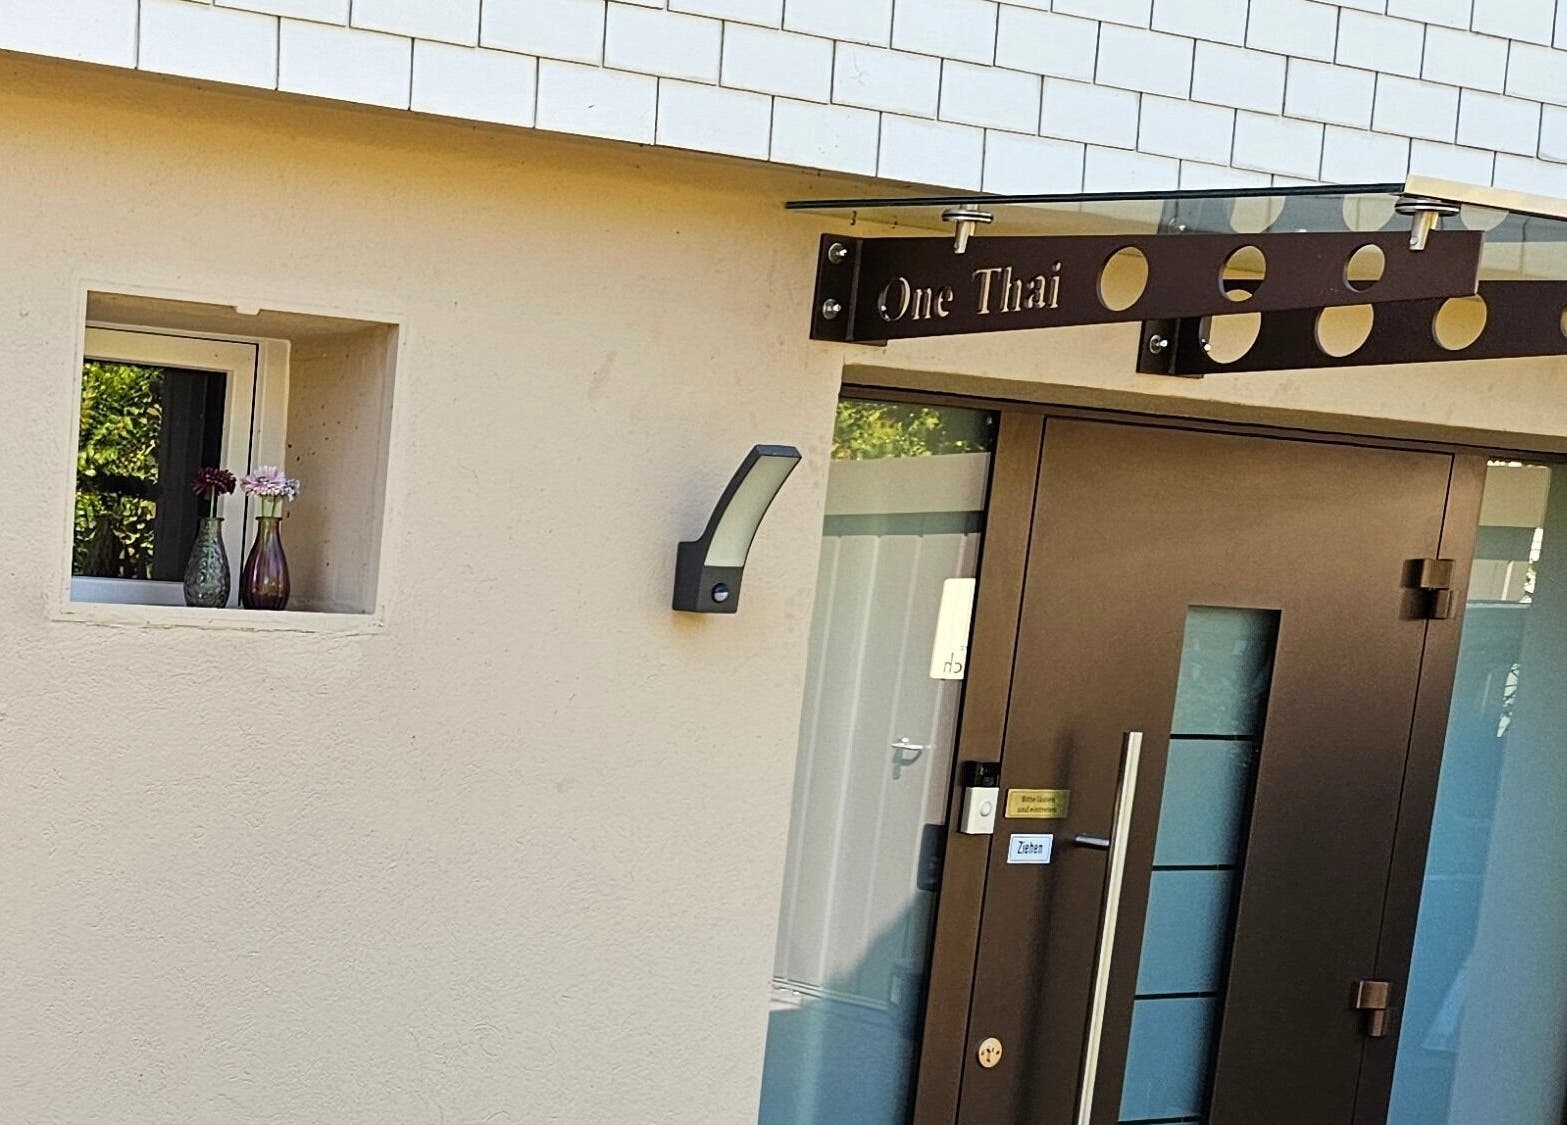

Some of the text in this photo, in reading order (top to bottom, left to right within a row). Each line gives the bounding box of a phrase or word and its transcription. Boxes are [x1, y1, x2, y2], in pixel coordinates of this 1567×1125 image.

[877, 262, 1062, 322] One Thai
[1017, 840, 1043, 854] Ziehen
